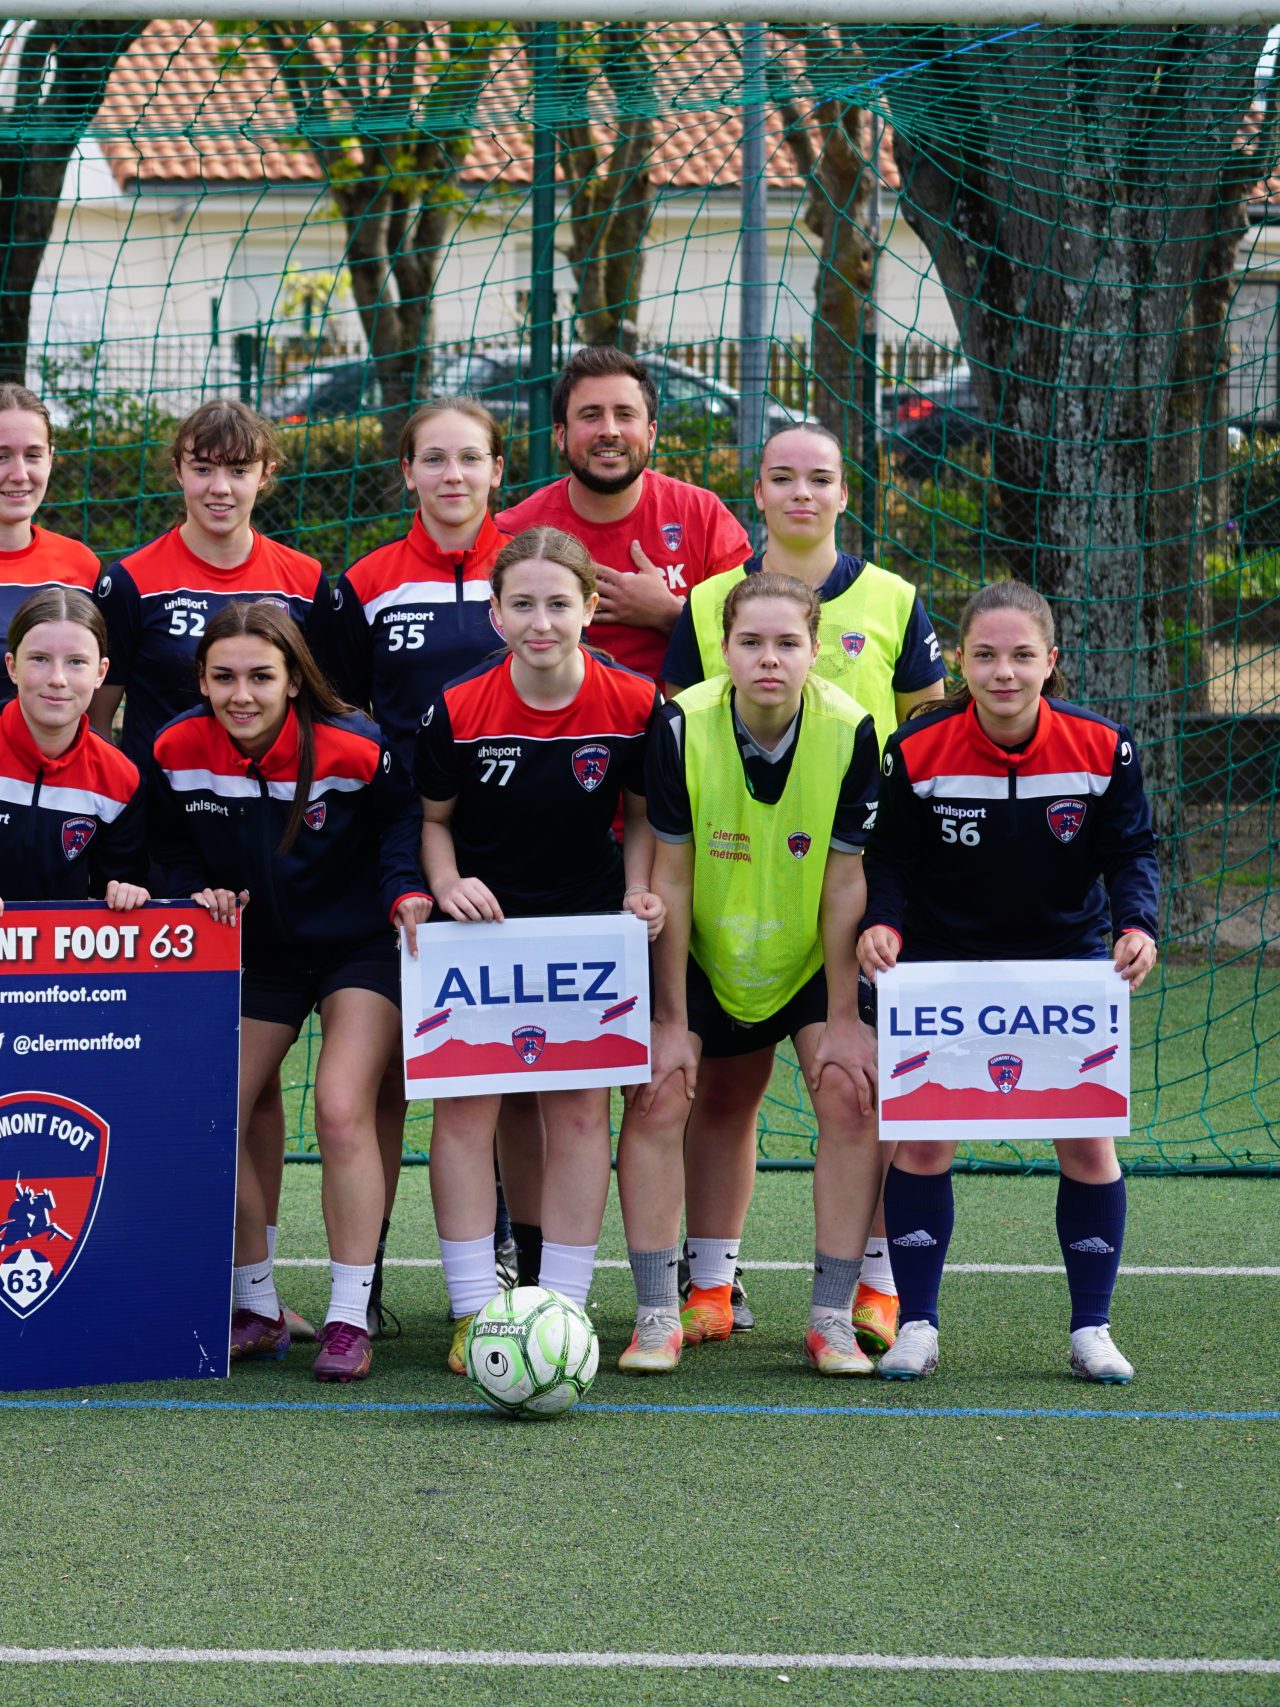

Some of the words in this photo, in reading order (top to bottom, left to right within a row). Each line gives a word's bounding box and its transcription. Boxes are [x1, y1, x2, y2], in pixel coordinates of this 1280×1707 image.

[164, 597, 208, 610] uhlsport
[169, 610, 205, 637] 52
[383, 611, 434, 624] uhlsport
[388, 624, 425, 652] 55
[478, 745, 521, 759] uhlsport
[479, 759, 516, 787] 77
[185, 800, 229, 816] uhlsport
[933, 804, 986, 819] uhlsport
[941, 818, 981, 846] 56
[54, 926, 139, 960] FOOT
[150, 924, 194, 959] 63
[434, 961, 618, 1008] ALLEZ
[890, 1005, 965, 1036] LES
[978, 1004, 1096, 1036] GARS
[13, 1033, 141, 1056] @clermontfoot
[49, 1116, 95, 1152] FOOT
[893, 1239, 937, 1247] adidas
[1070, 1243, 1114, 1253] adidas
[7, 1269, 42, 1294] 63
